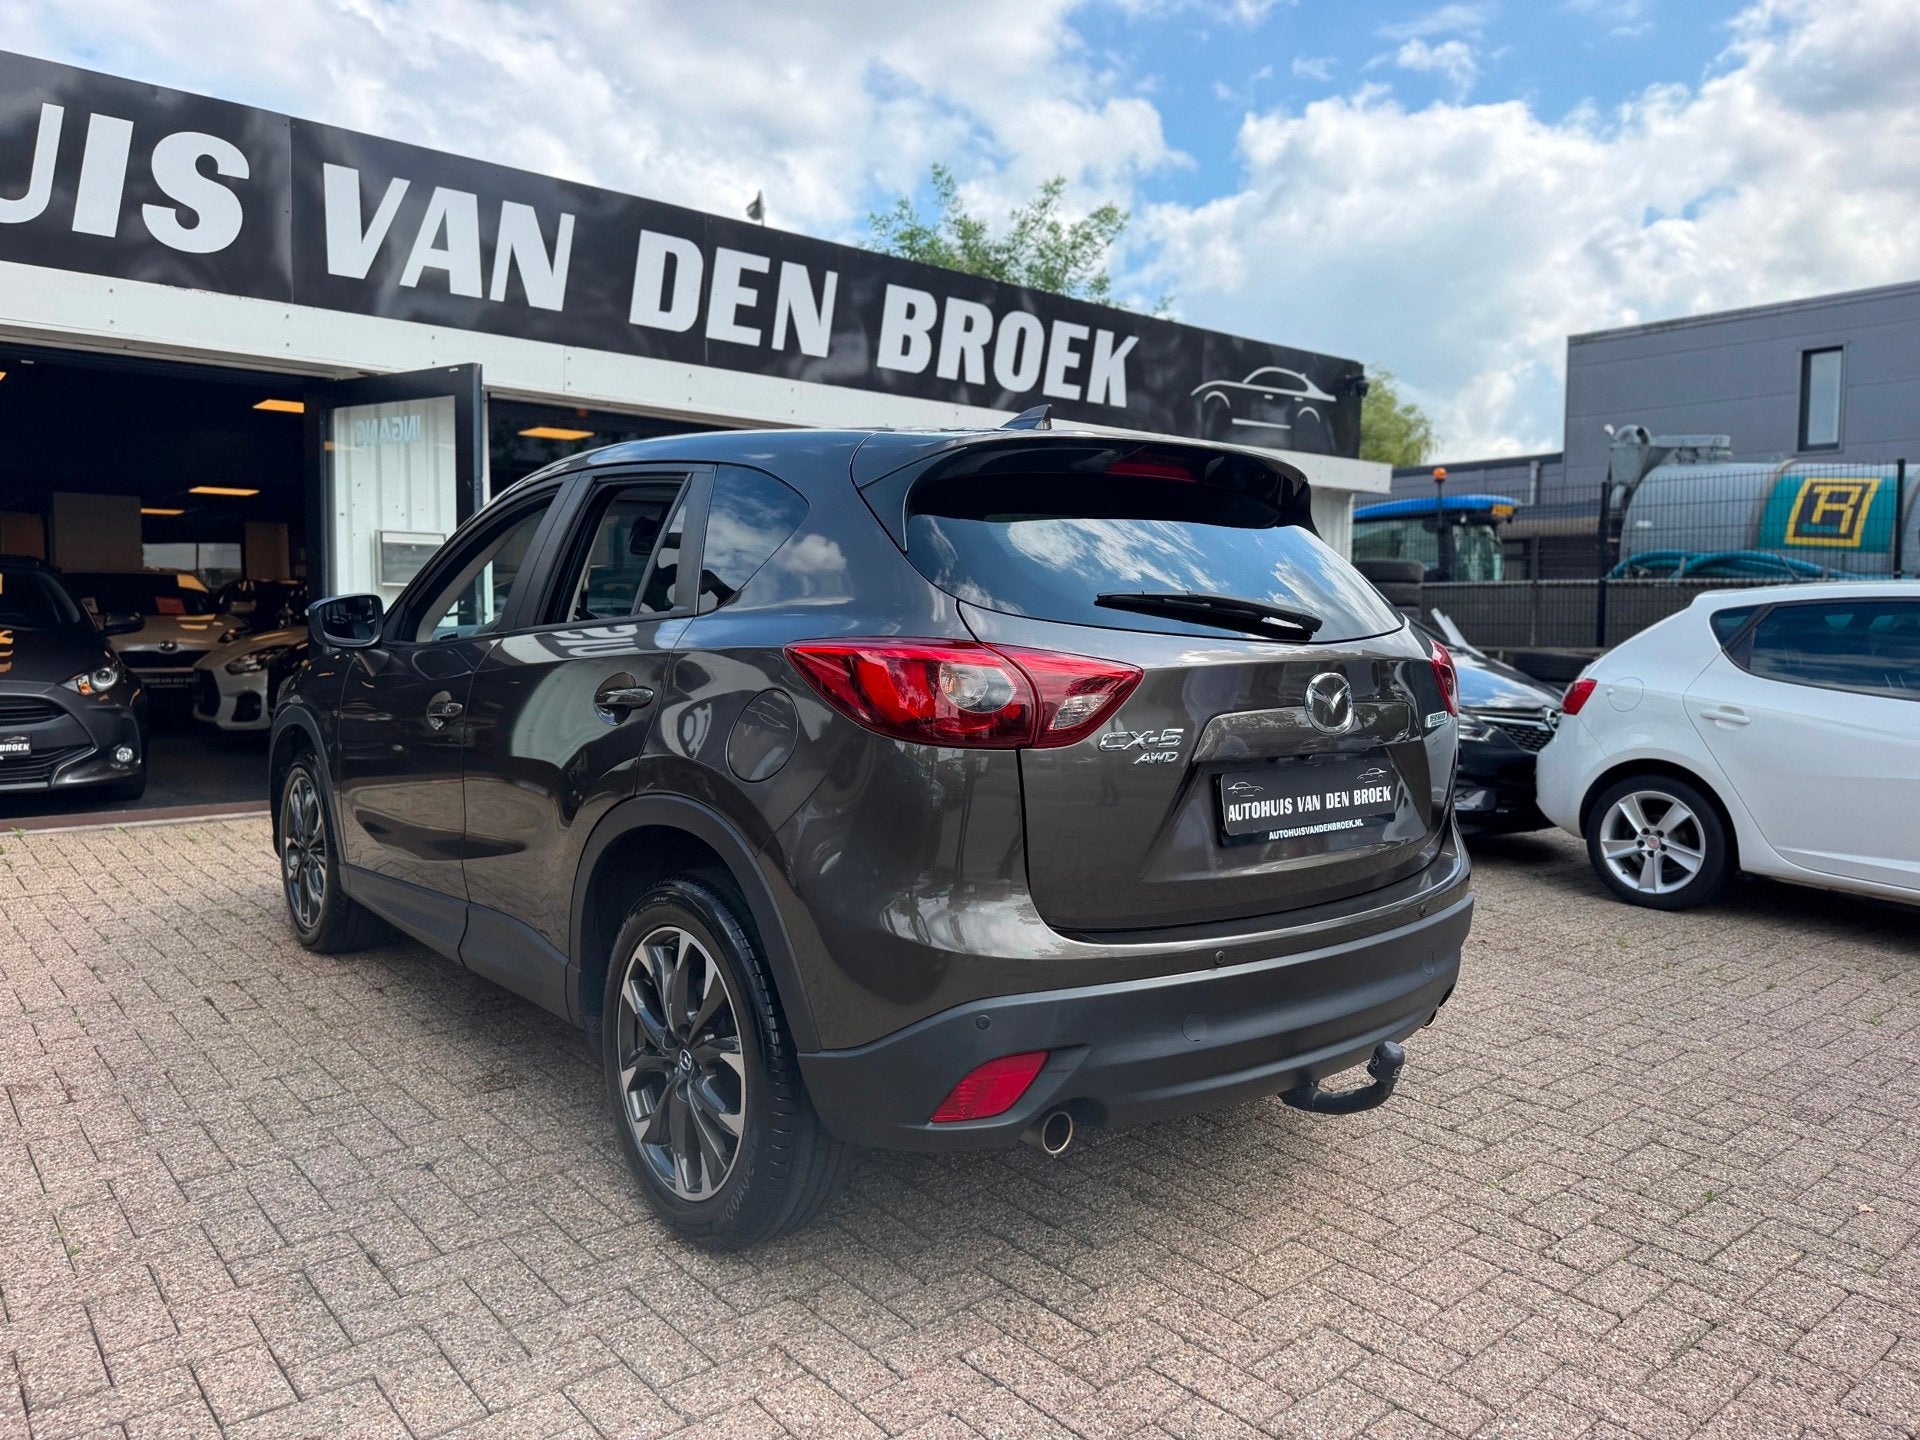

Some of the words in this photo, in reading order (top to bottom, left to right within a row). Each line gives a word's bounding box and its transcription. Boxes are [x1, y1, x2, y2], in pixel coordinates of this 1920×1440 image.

[323, 162, 575, 311] VAN
[629, 229, 838, 358] DEN
[877, 283, 1139, 407] BROEK
[1099, 728, 1184, 751] CX-5
[1133, 751, 1179, 765] AWD
[1228, 797, 1293, 822] AUTOHUIS
[1296, 793, 1321, 813] VAN
[1325, 790, 1350, 810] DEN
[1353, 785, 1392, 806] BROEK
[1268, 818, 1364, 841] AUTOHUISVANDENBROEK.NL
